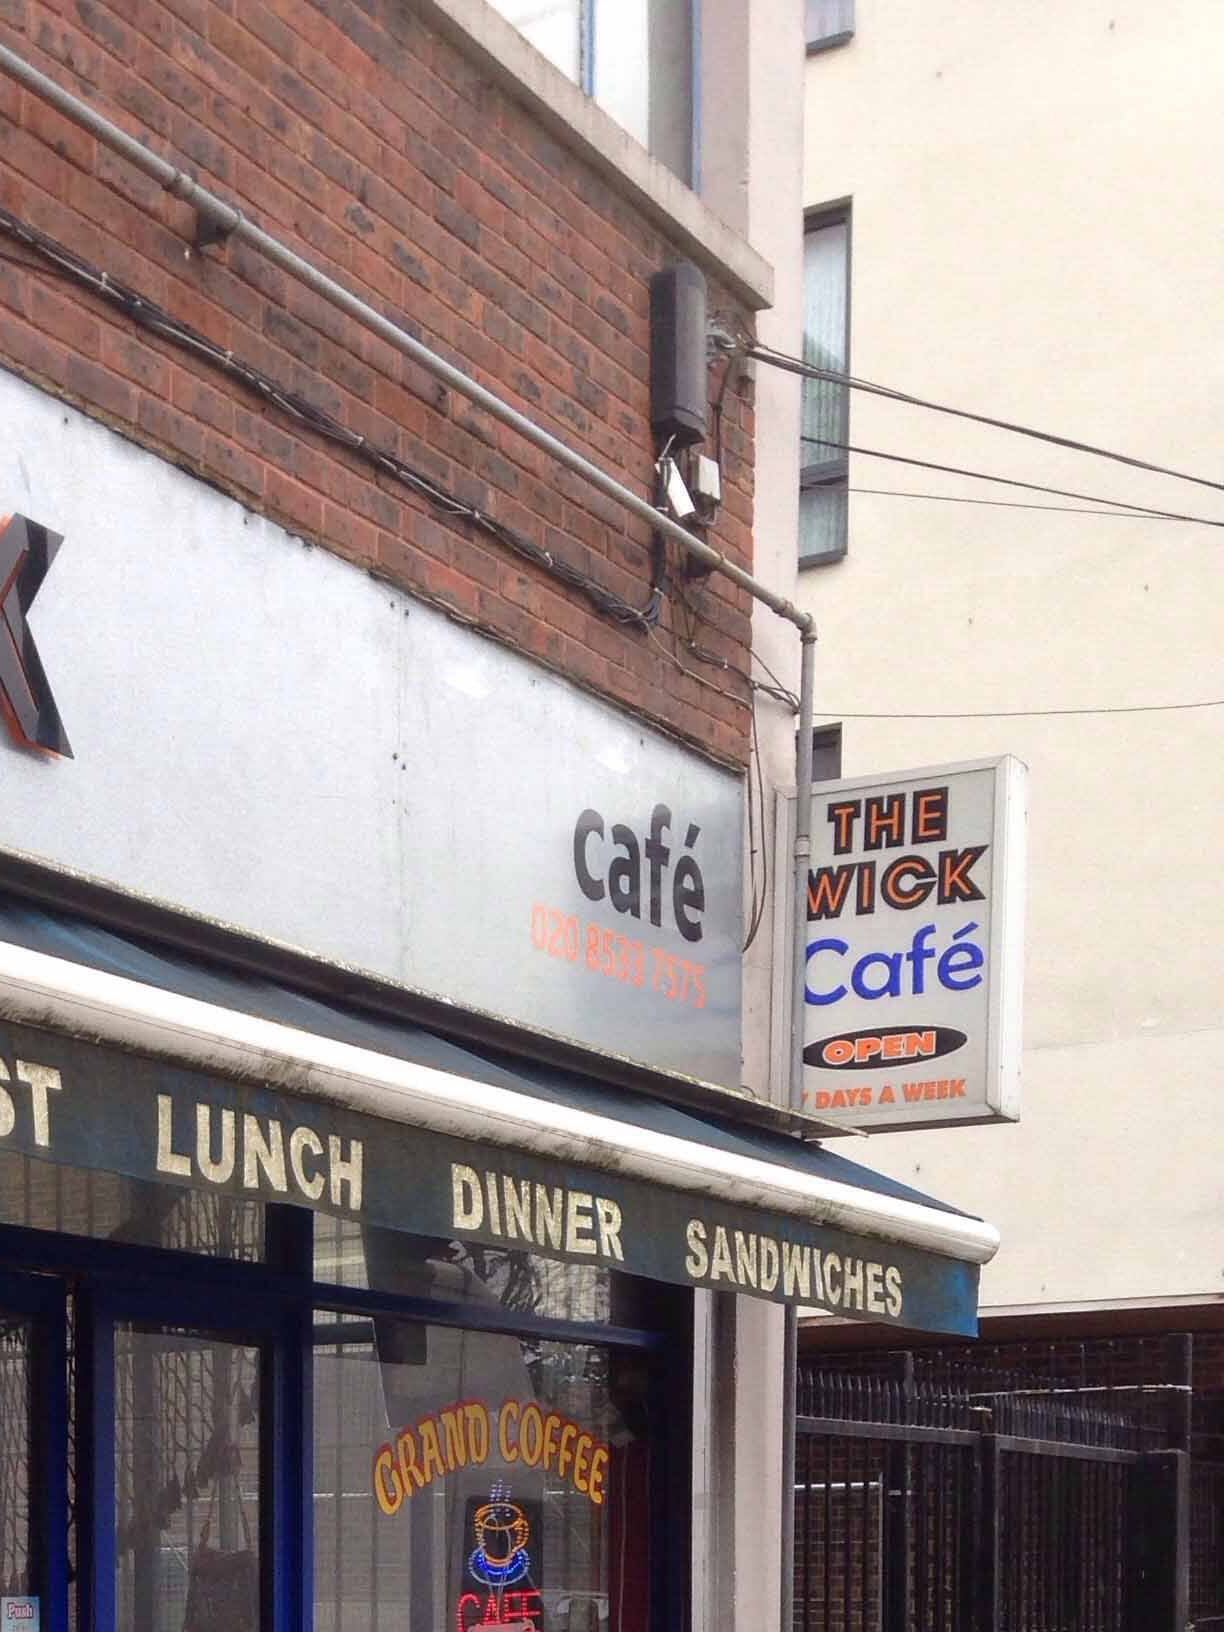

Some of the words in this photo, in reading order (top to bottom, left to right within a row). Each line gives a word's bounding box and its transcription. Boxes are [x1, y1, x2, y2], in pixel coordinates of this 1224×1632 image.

[827, 787, 949, 855] THE
[807, 845, 989, 921] WICK
[531, 902, 580, 963] 020
[804, 922, 984, 1006] Café
[823, 1031, 936, 1065] OPEN
[816, 1088, 872, 1109] DAYS
[878, 1086, 895, 1104] A
[903, 1079, 967, 1102] WEEK
[156, 1094, 363, 1211] LUNCH
[450, 1162, 625, 1261] DINNER
[685, 1218, 904, 1317] SANDWICHES
[373, 1398, 490, 1516] GRAND
[497, 1398, 610, 1504] COFFEE
[7, 1602, 34, 1620] Push
